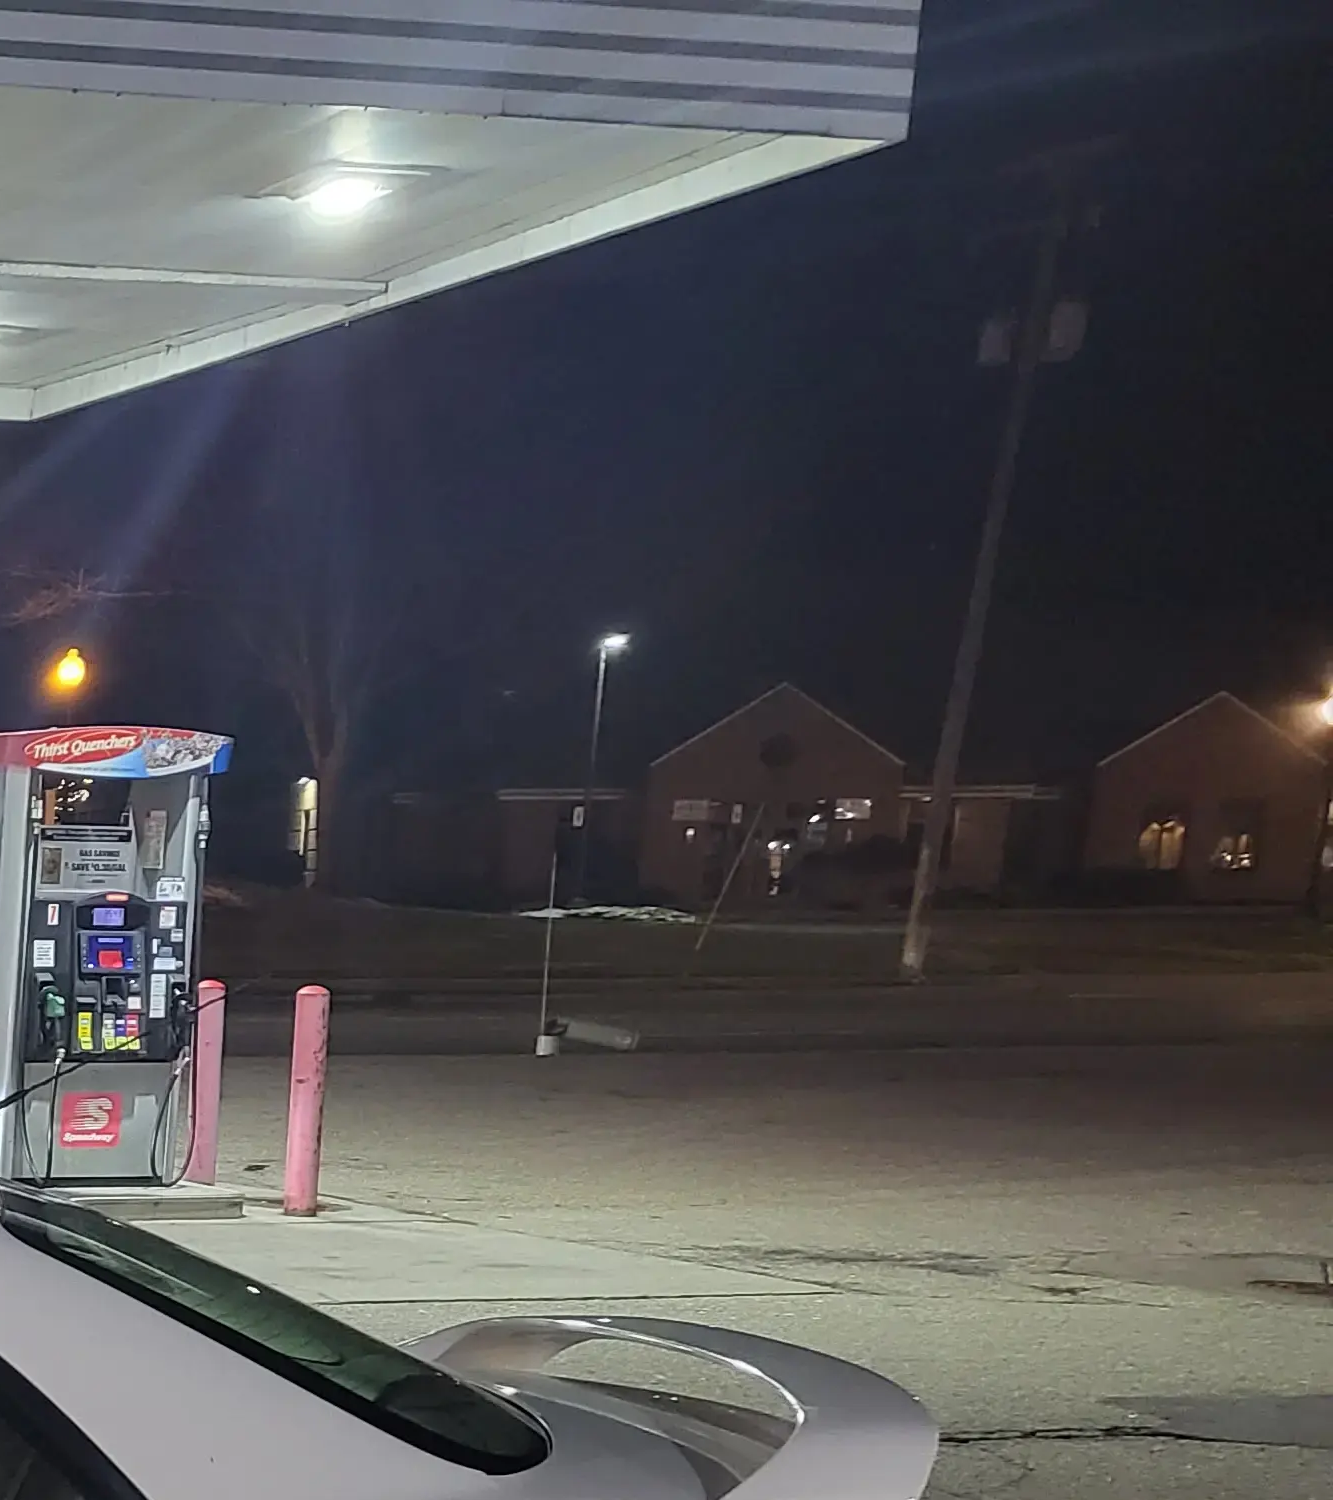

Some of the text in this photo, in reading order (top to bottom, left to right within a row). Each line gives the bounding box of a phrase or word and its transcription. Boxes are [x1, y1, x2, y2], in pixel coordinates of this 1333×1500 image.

[33, 735, 137, 759] Thirst Quenchers
[50, 906, 56, 923] 7
